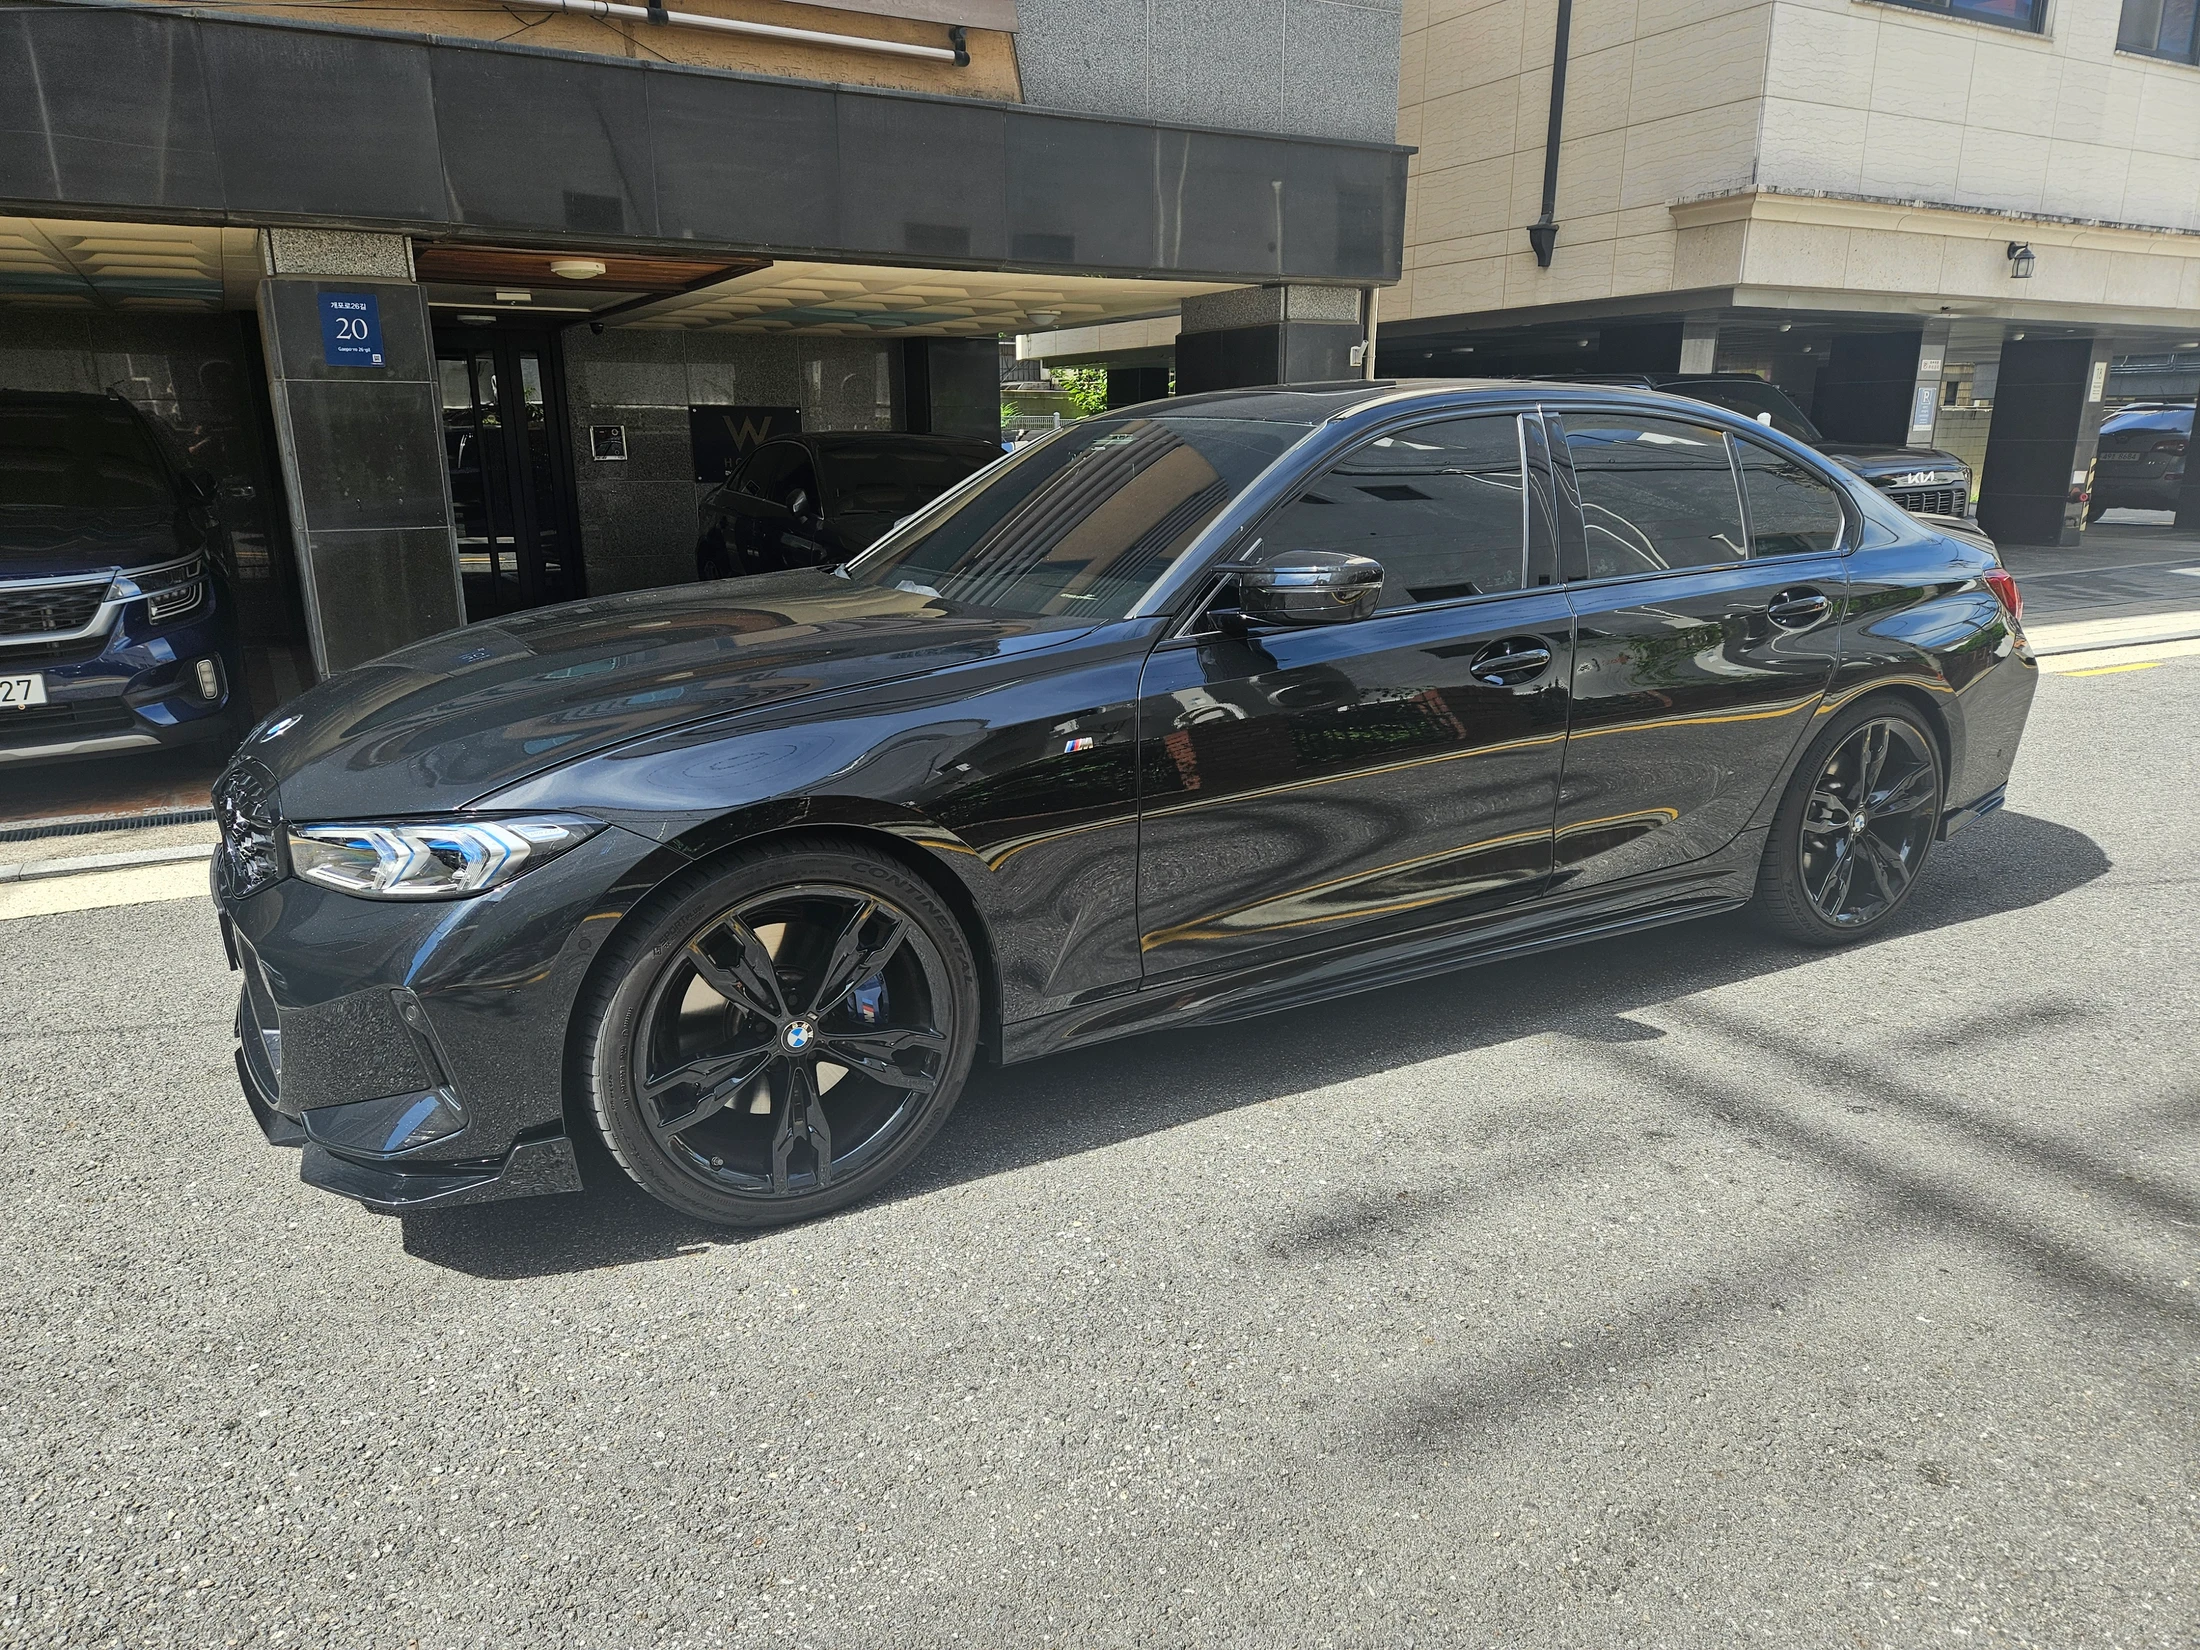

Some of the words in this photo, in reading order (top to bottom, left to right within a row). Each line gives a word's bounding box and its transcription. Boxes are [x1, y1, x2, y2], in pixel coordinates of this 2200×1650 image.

[335, 317, 368, 340] 20
[722, 415, 773, 452] W
[1907, 471, 1935, 484] KIA
[0, 679, 31, 702] 27
[851, 862, 973, 988] CONTINENTAL
